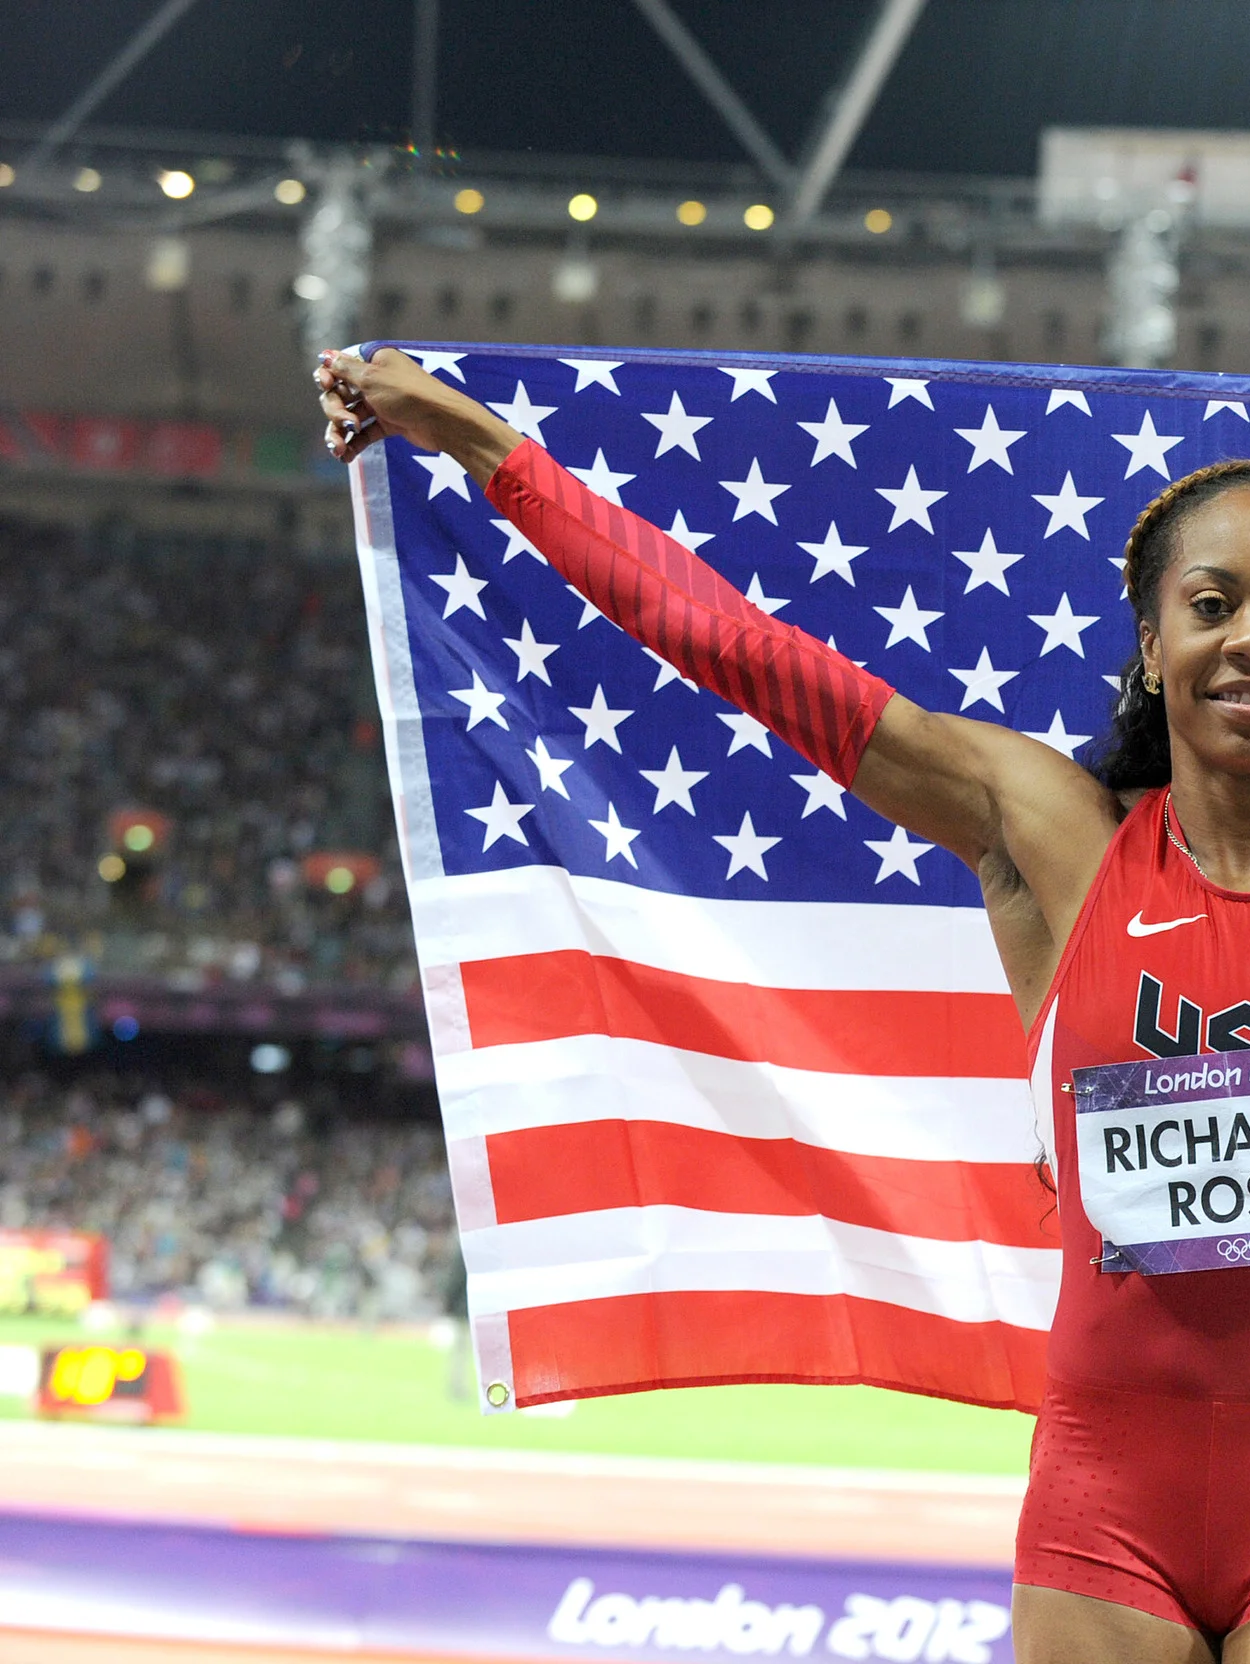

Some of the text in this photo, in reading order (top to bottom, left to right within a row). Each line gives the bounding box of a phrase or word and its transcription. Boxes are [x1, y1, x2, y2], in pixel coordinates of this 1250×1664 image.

[1145, 1062, 1241, 1096] London
[549, 1577, 1010, 1664] London 2012
